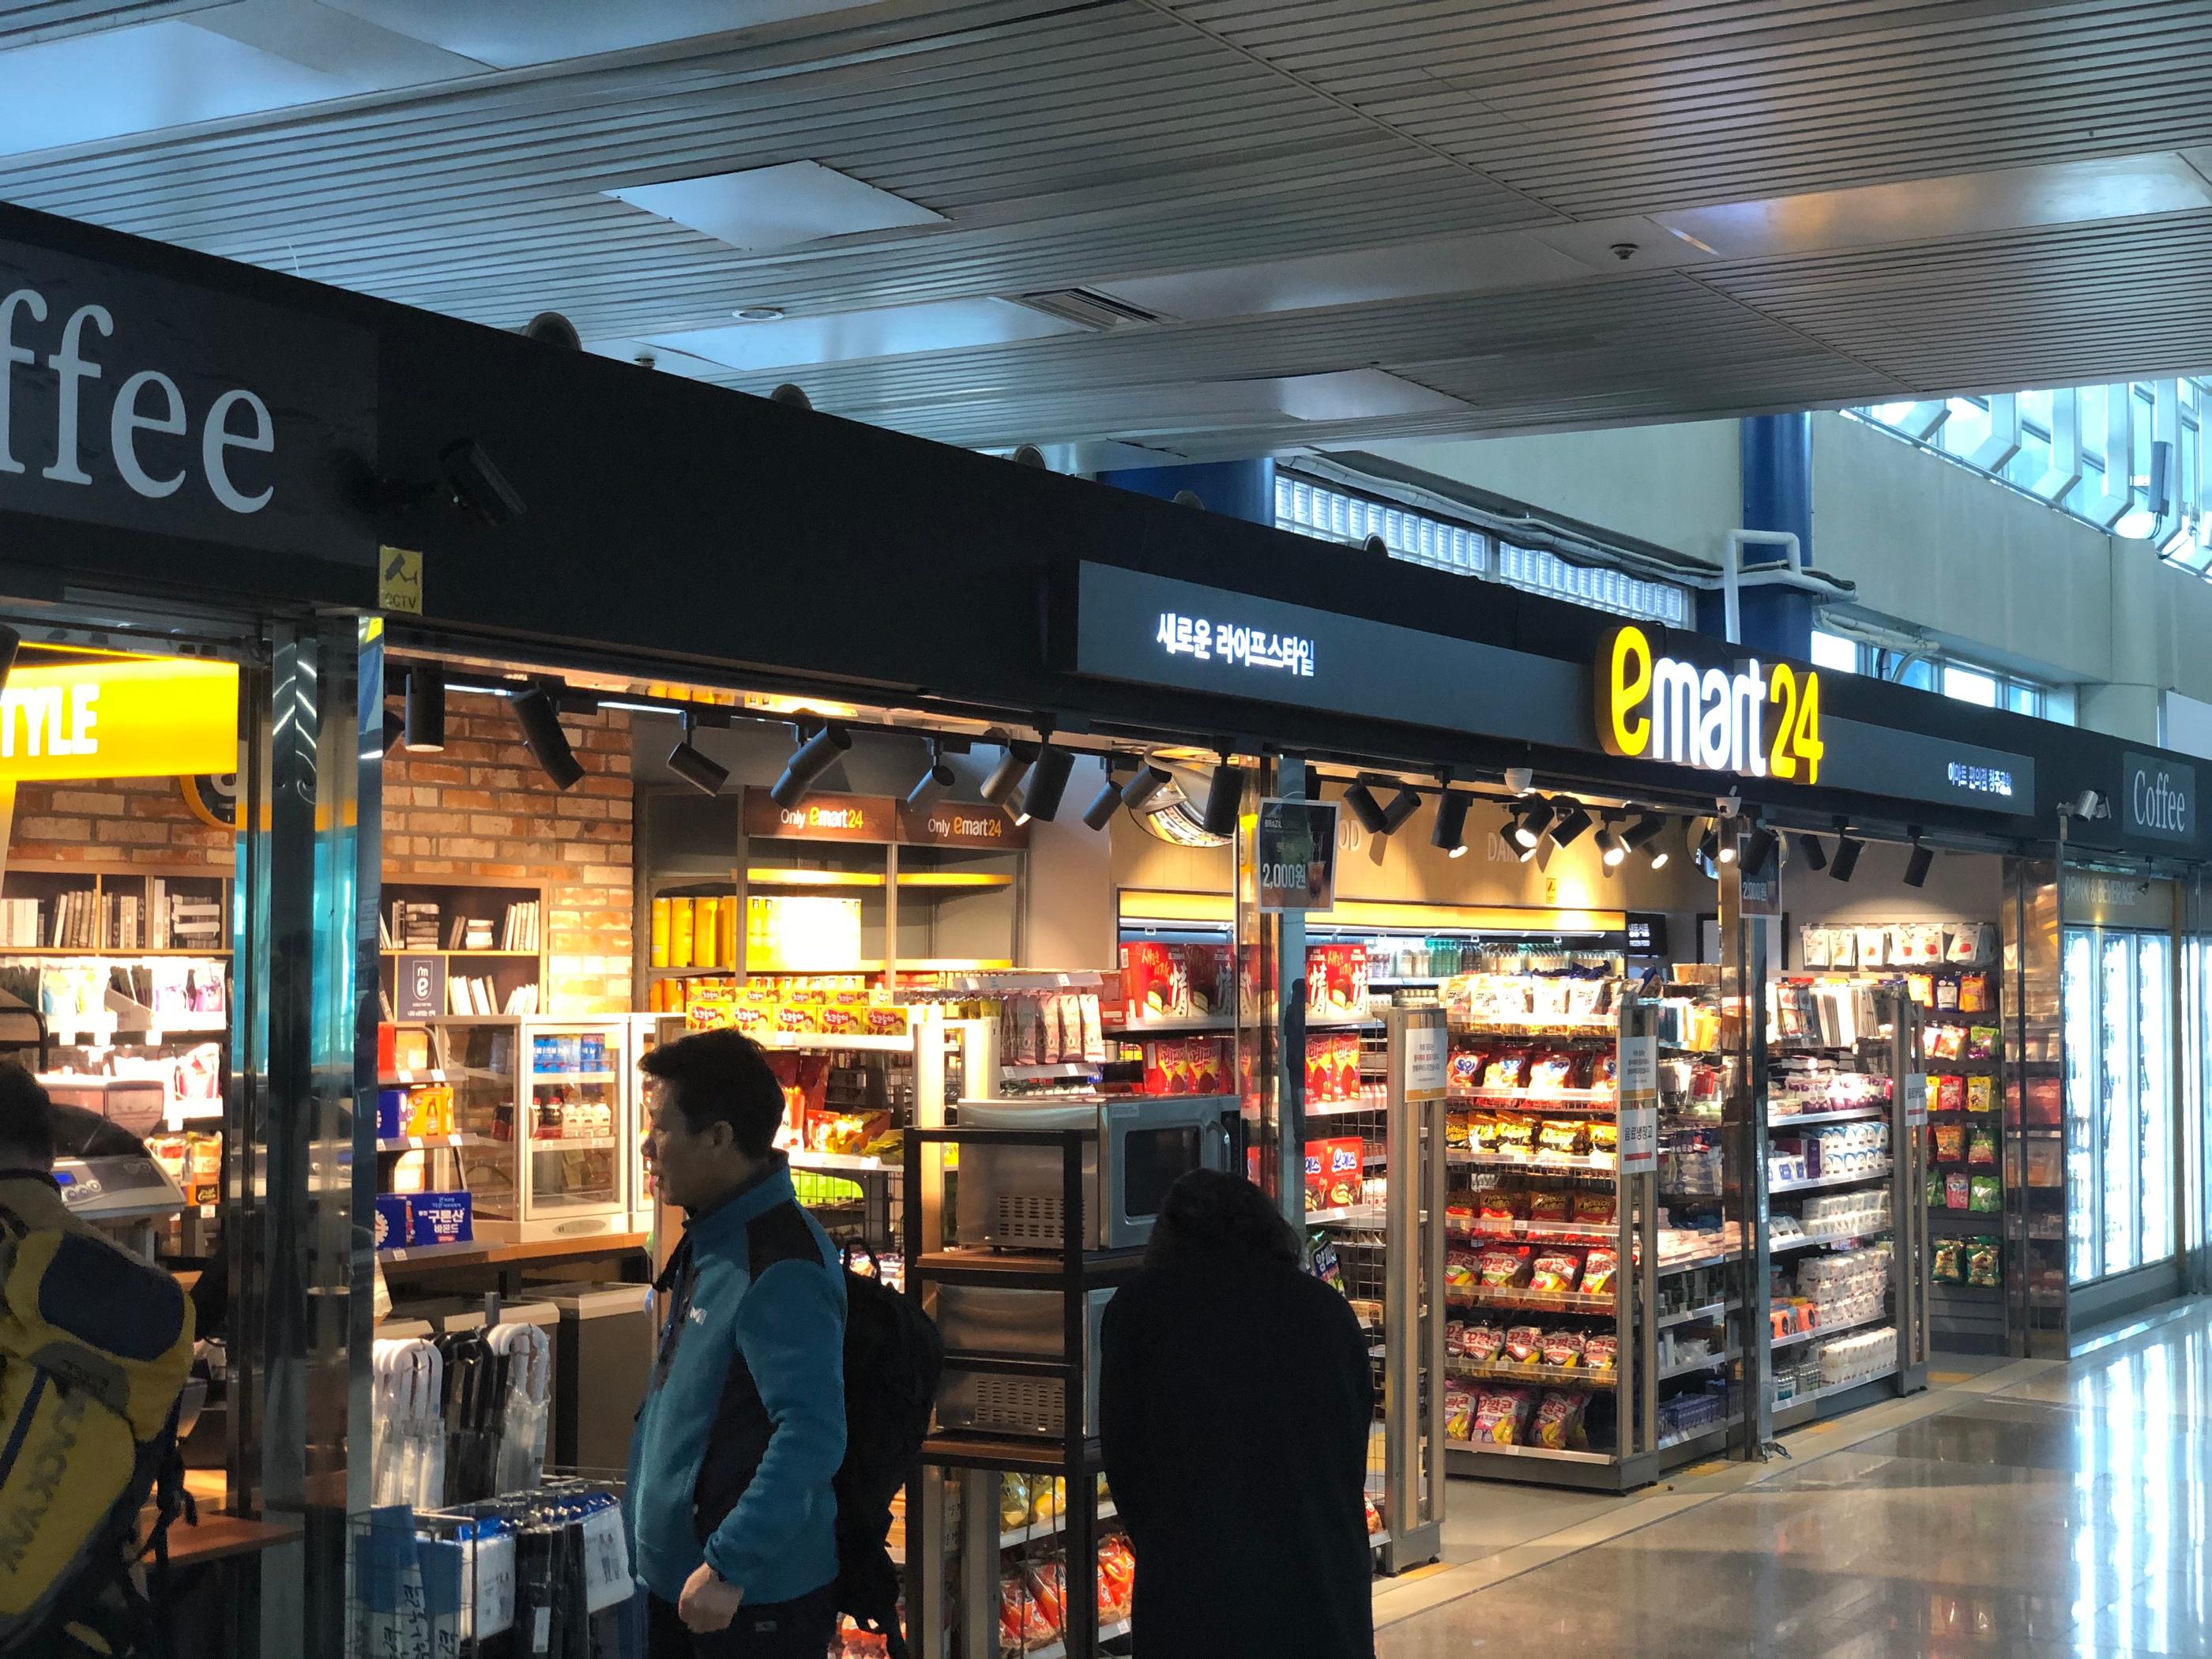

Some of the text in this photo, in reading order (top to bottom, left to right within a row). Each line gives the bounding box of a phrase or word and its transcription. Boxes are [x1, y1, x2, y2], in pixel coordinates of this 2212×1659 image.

[386, 593, 416, 609] CCTV
[1156, 613, 1315, 677] 새로운 라이프스타일
[1612, 626, 1824, 784] emart24
[1947, 761, 1967, 787] 이마트
[1969, 765, 1988, 791] 편의점
[2134, 769, 2185, 832] Coffee
[781, 807, 864, 830] Only emart24
[928, 816, 1002, 837] Only emart24
[1488, 832, 1520, 862] DAI
[1262, 863, 1306, 890] 2,000원
[1624, 1125, 1653, 1142] 음료냉장고
[1305, 1156, 1321, 1175] 예스
[428, 1209, 464, 1223] 구론산
